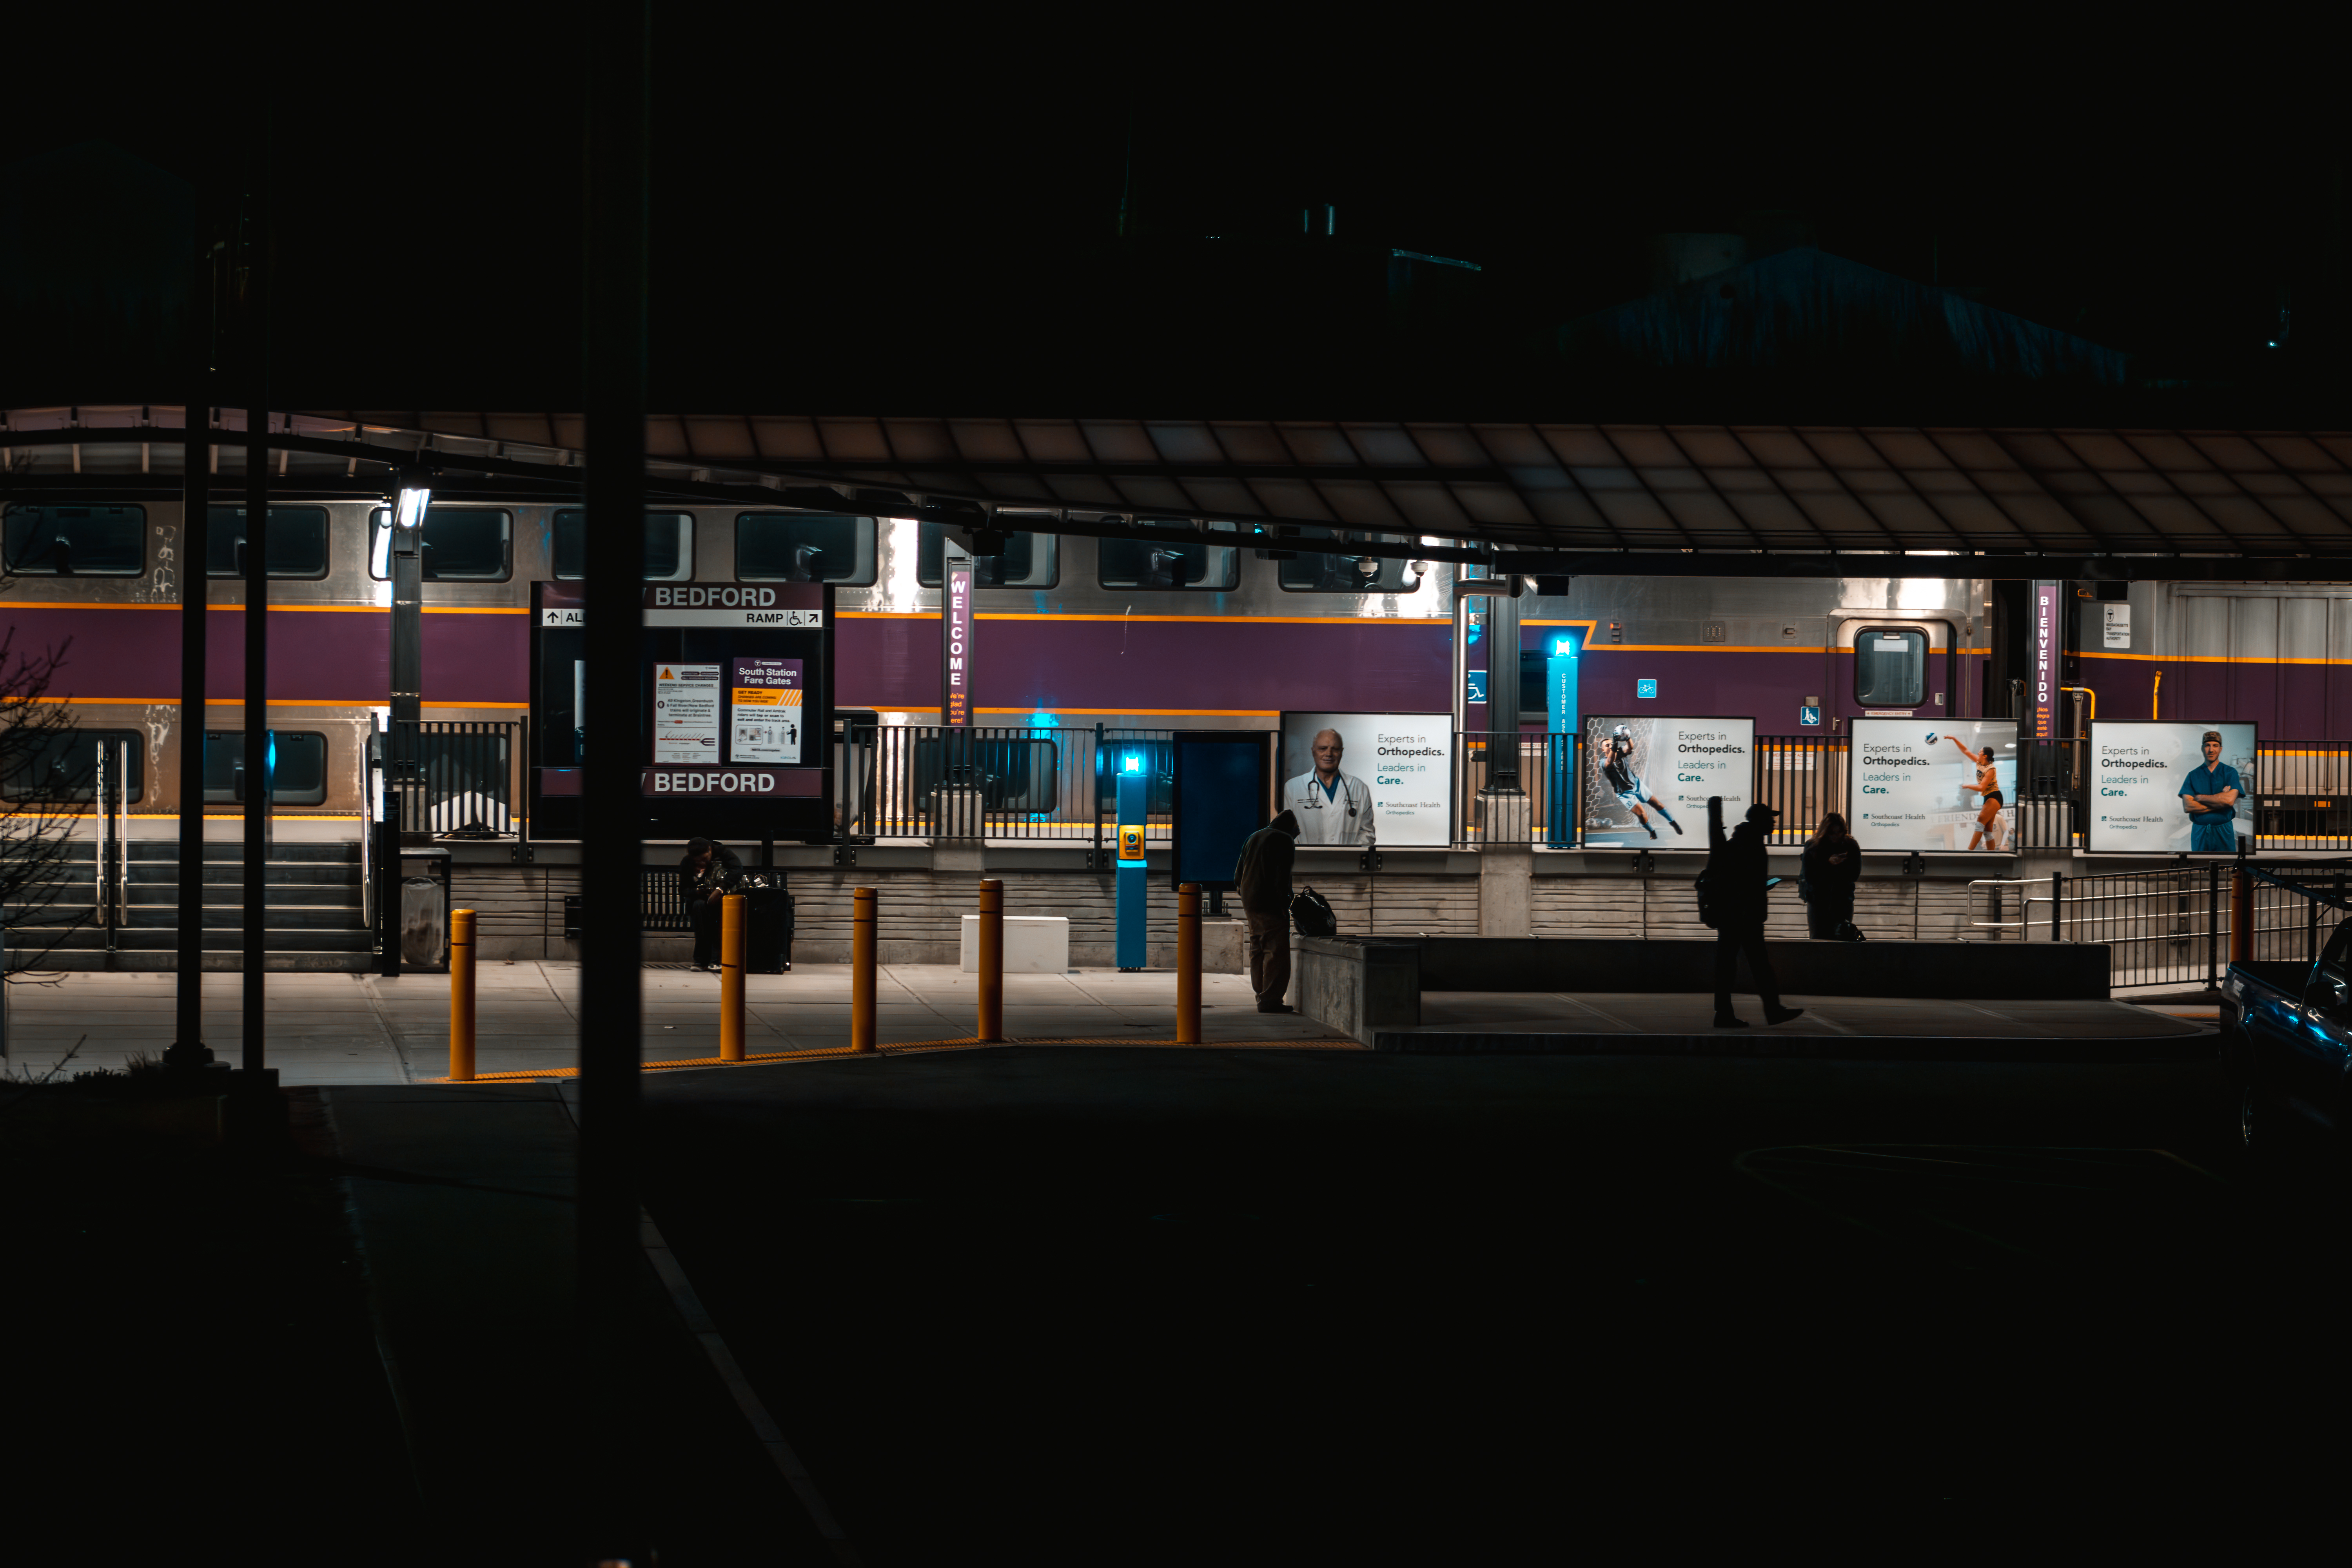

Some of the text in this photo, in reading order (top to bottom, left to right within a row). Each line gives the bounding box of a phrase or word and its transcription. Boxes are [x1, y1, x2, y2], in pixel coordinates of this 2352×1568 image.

[656, 588, 776, 606] BEDFORD
[746, 613, 784, 623] RAMP
[950, 581, 965, 685] WELCOME
[2038, 596, 2048, 702] BIENVENIDO
[1378, 734, 1426, 746] Experts in
[1679, 731, 1726, 743] Experts in
[1377, 747, 1445, 758] Orthopedics.
[1678, 744, 1745, 755] Orthopedics.
[1863, 743, 1900, 755] Experts
[2102, 746, 2138, 757] Experts
[1377, 763, 1414, 771] Leaders
[1678, 760, 1715, 769] Leaders
[1863, 756, 1930, 767] Orthopedics.
[2101, 759, 2167, 770] Orthopedics.
[655, 773, 775, 791] BEDFORD
[1377, 776, 1404, 784] Care.
[1678, 773, 1704, 782] Care.
[1863, 772, 1900, 781] Leaders
[2101, 775, 2149, 784] Leaders in
[1863, 785, 1889, 794] Care.
[2101, 788, 2127, 796] Care.
